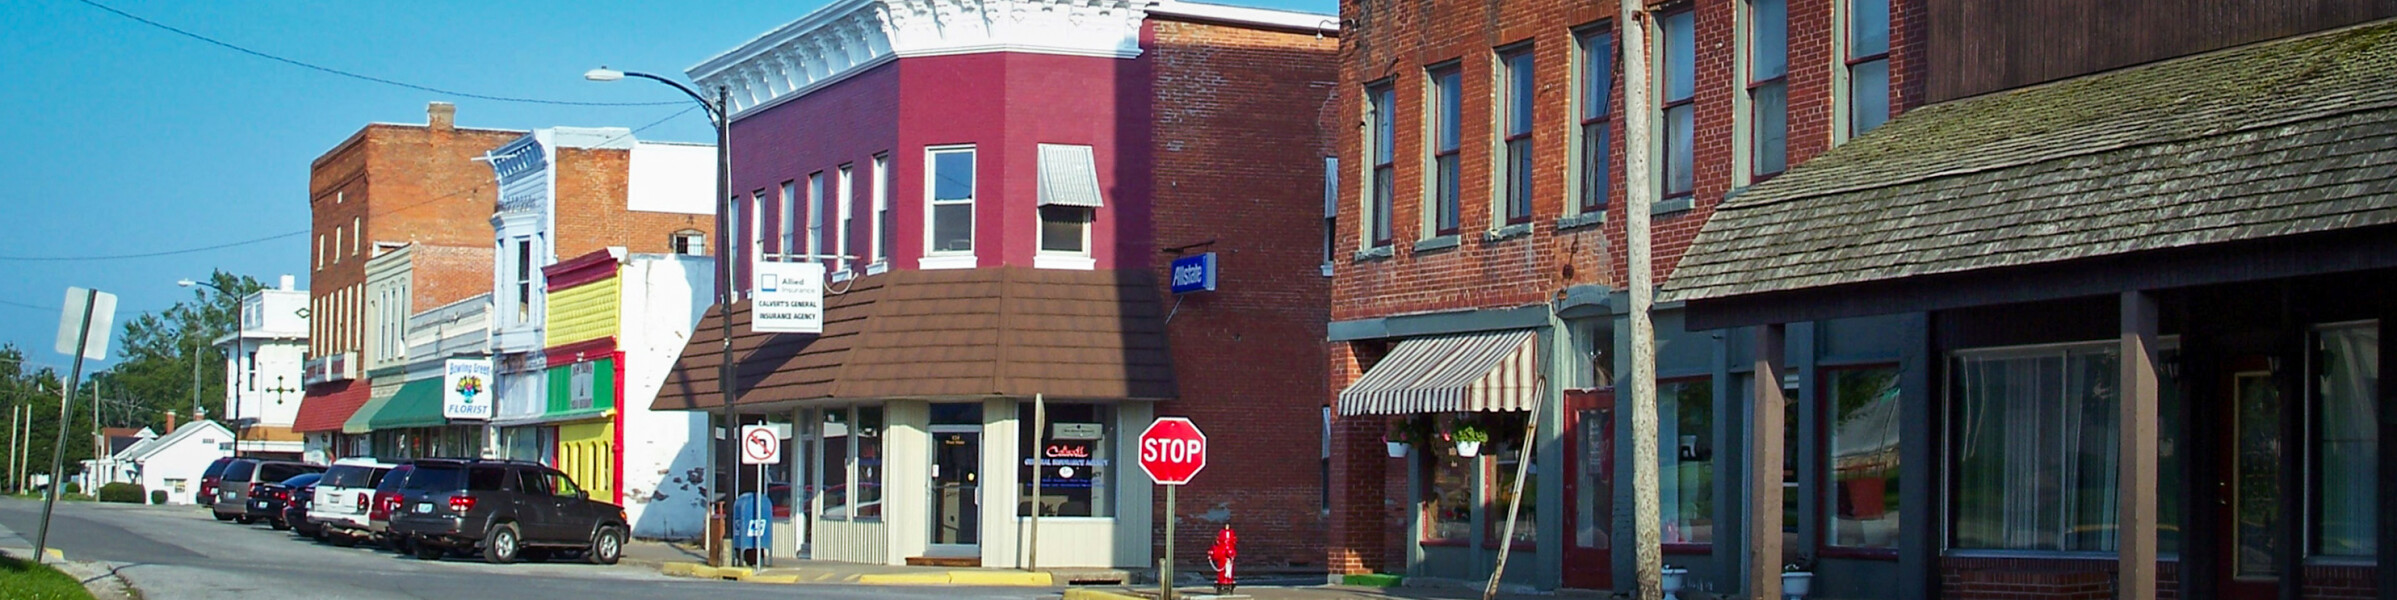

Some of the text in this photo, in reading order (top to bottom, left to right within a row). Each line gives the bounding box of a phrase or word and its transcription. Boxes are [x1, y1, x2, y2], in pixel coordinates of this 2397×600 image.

[1172, 263, 1202, 287] Allstate
[449, 362, 491, 377] Bowling Green
[448, 404, 488, 414] FLORIST
[1143, 437, 1202, 464] STOP
